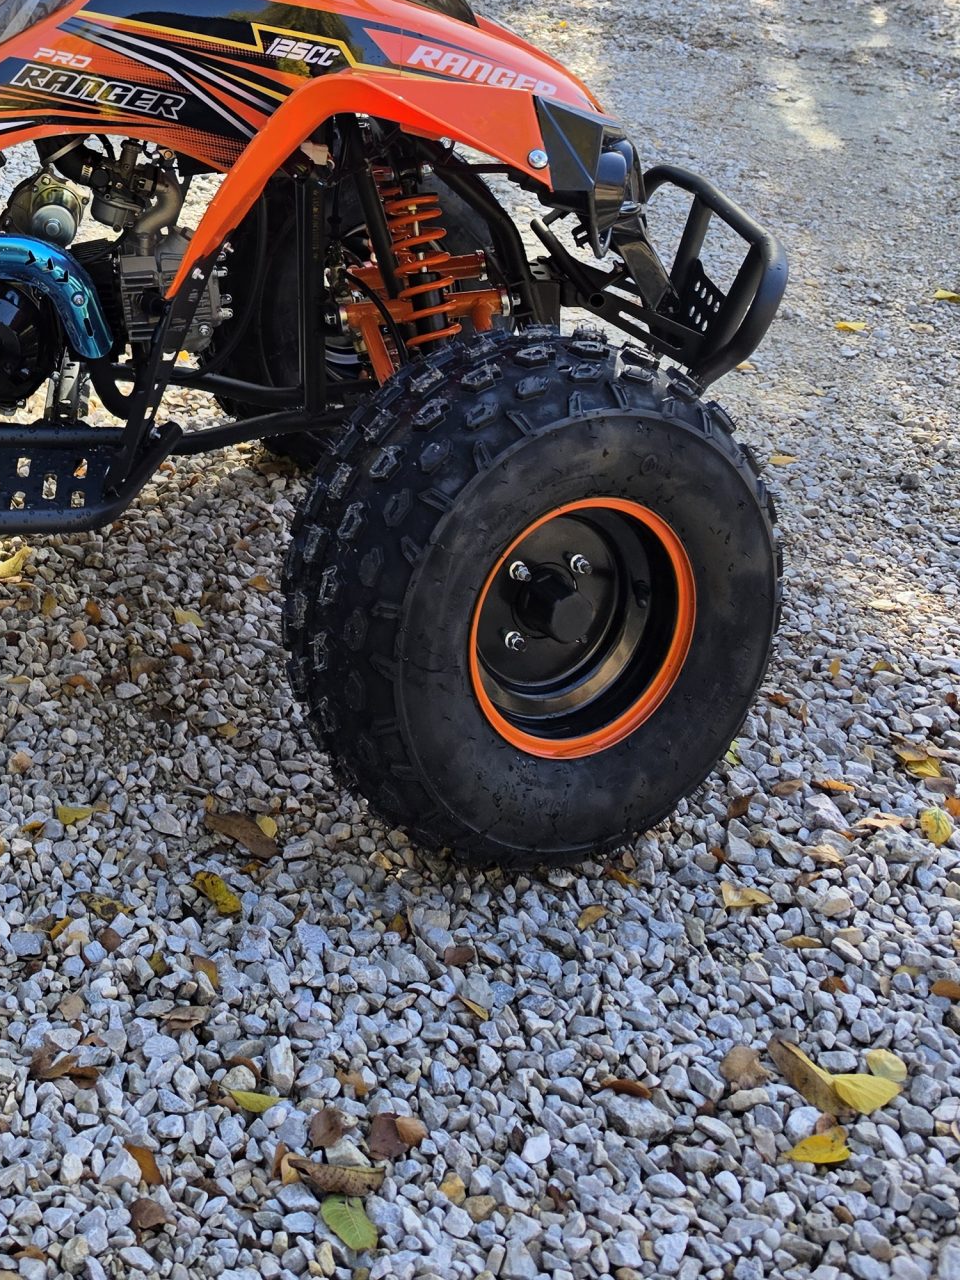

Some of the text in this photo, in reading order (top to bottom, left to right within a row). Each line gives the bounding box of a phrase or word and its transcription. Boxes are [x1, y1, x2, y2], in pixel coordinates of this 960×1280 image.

[33, 47, 93, 69] PRO
[265, 37, 340, 67] 125CC
[10, 63, 187, 121] RANGER
